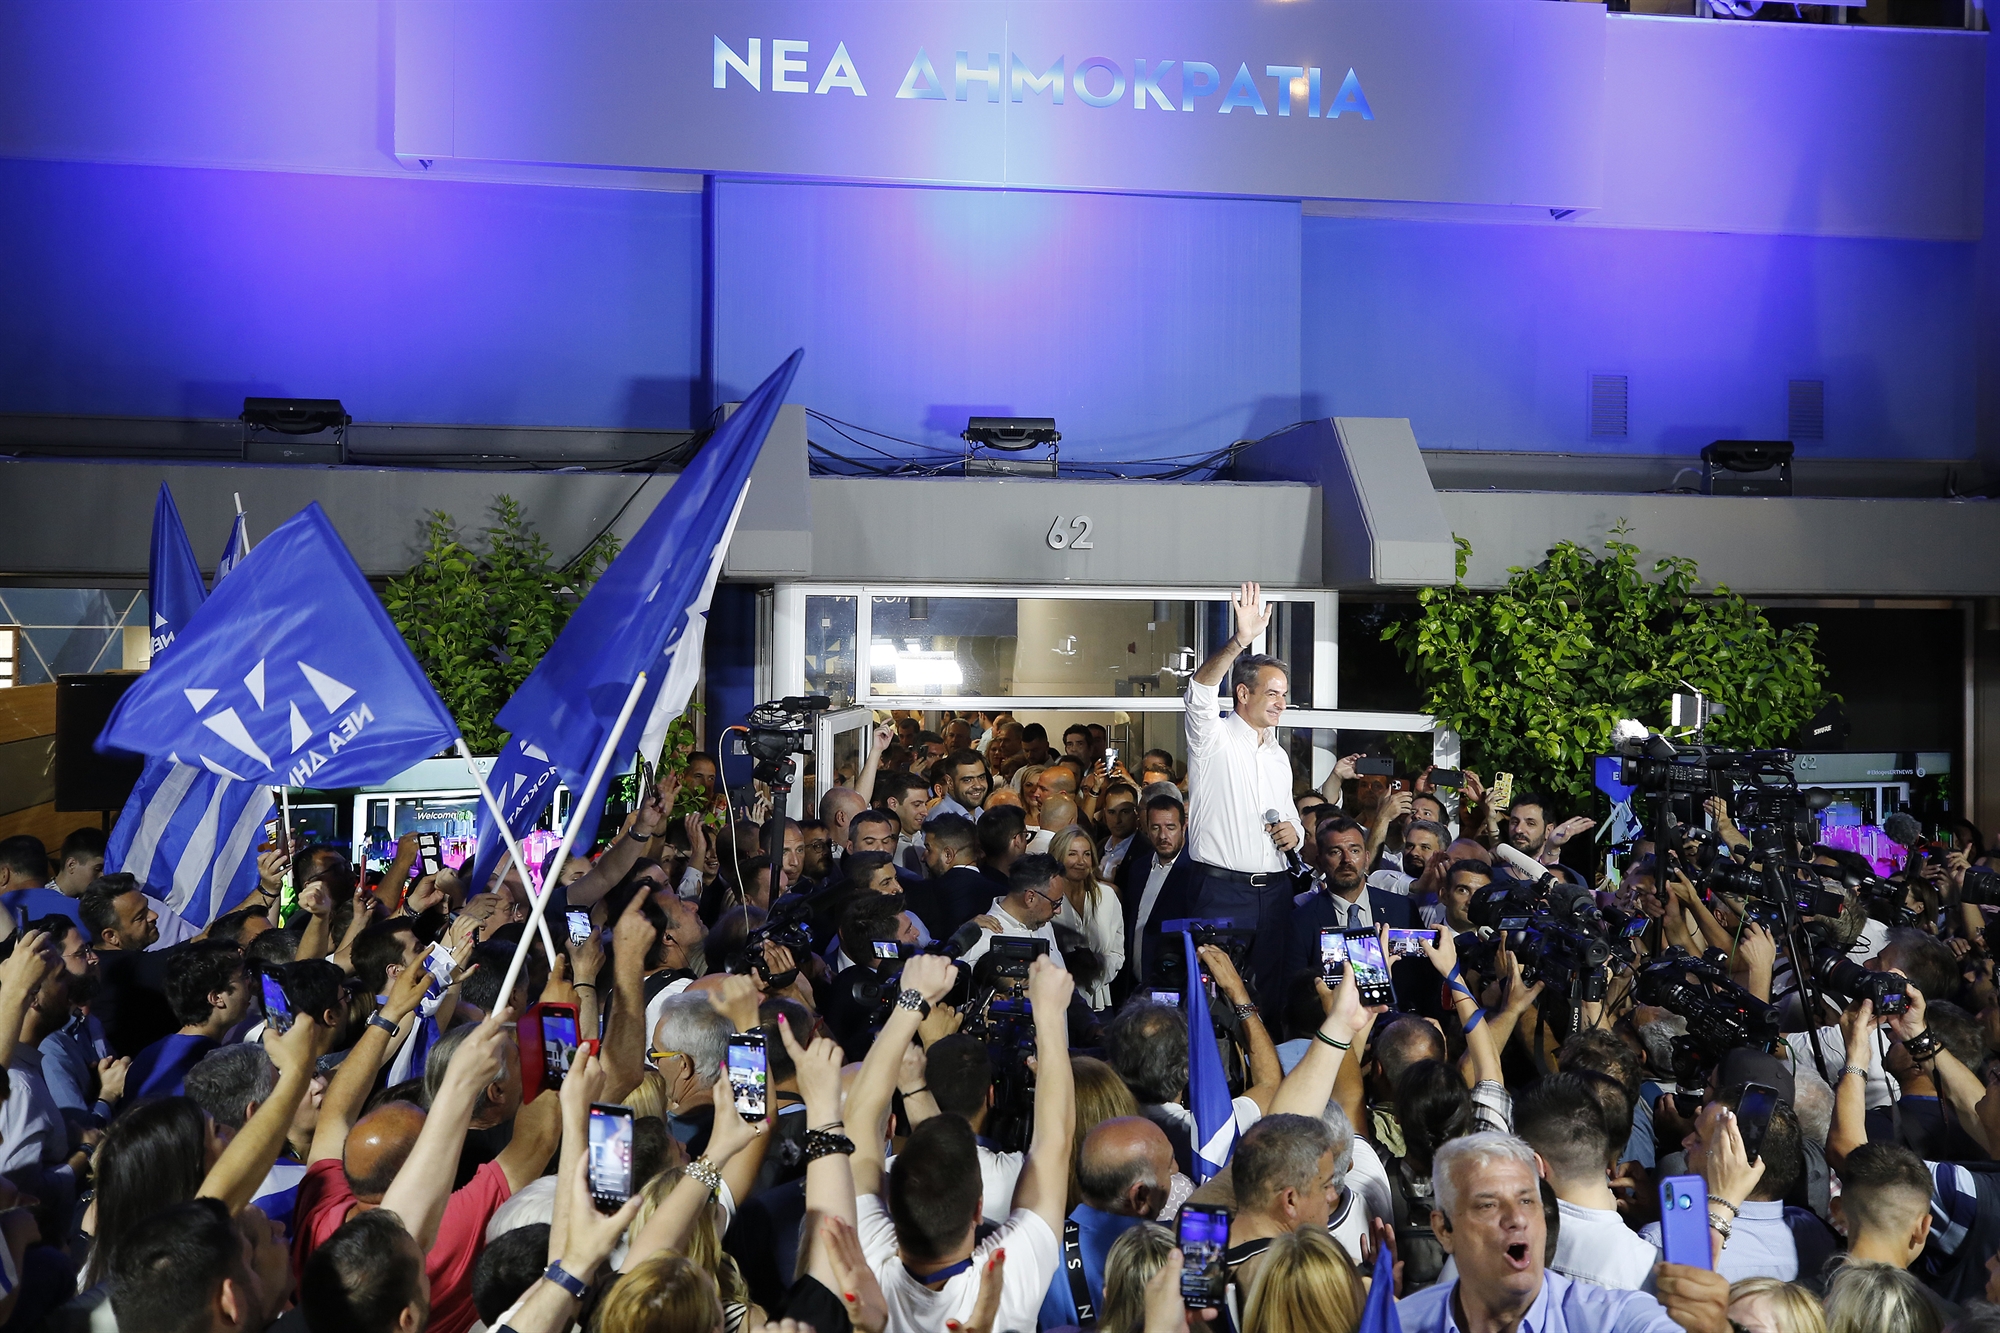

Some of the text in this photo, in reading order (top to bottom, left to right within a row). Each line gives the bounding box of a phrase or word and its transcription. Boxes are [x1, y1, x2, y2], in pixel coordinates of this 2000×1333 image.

[713, 34, 1375, 121] ΝΕΑ ΔΗΜΟΚΡΑΤΙΑ
[1045, 515, 1094, 550] 62
[1799, 755, 1818, 770] 62
